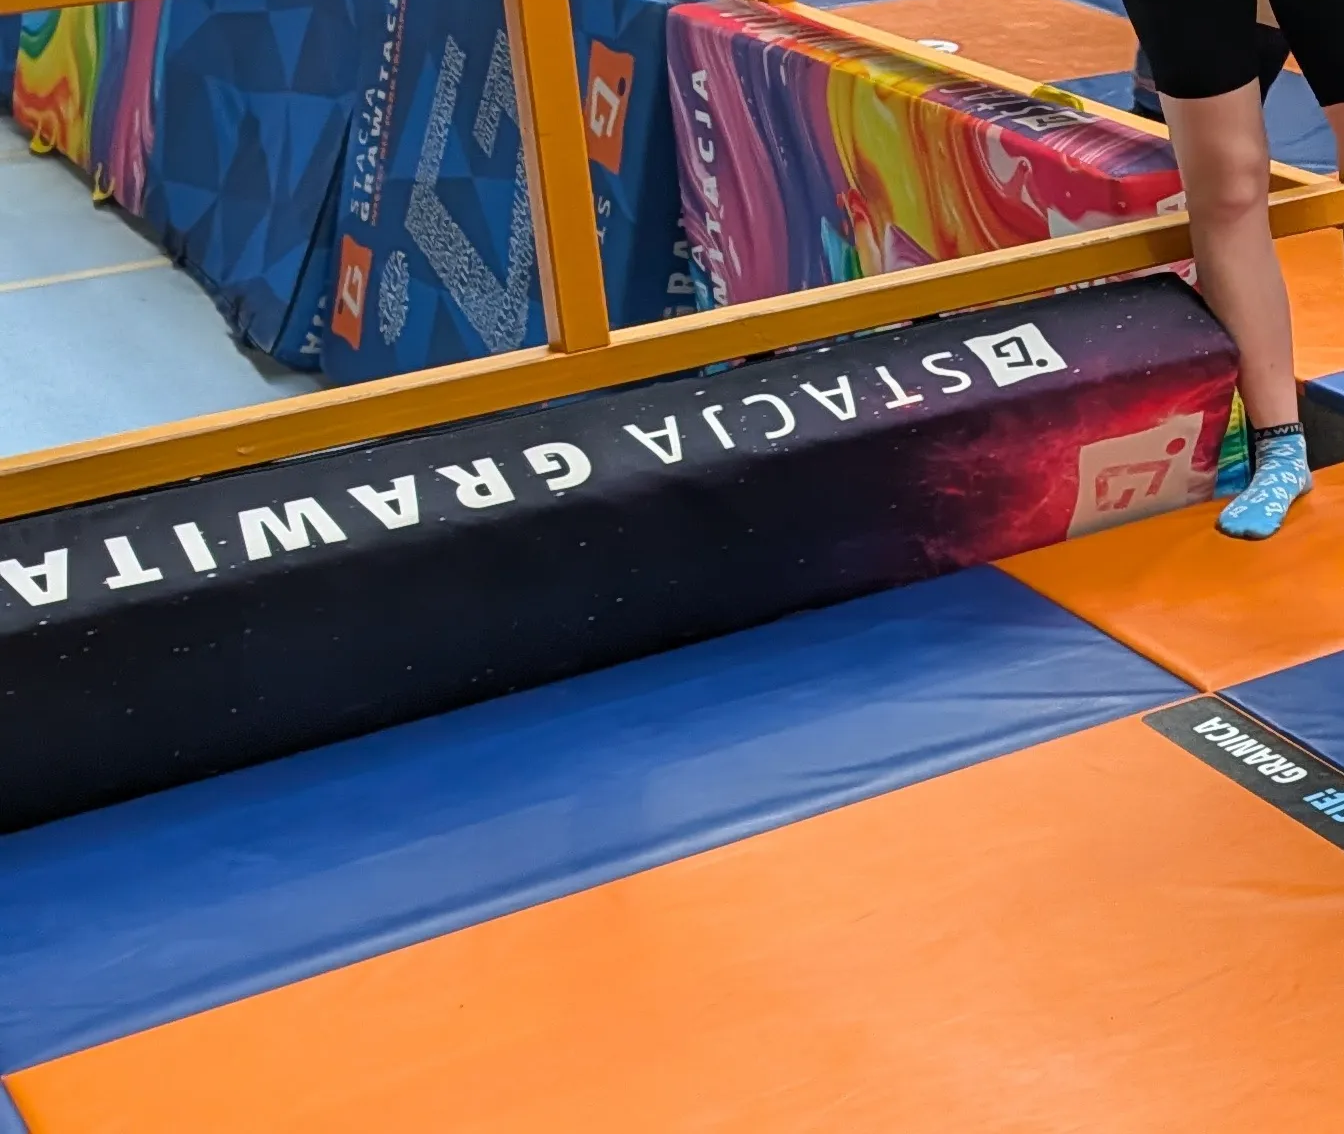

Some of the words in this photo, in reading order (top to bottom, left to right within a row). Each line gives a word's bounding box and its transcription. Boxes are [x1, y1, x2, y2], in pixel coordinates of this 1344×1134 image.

[350, 87, 377, 215] STACJA
[691, 68, 728, 308] WITACJA
[626, 351, 974, 466] STACJA
[0, 440, 592, 608] GRAWITA
[1192, 716, 1309, 785] GRANICA
